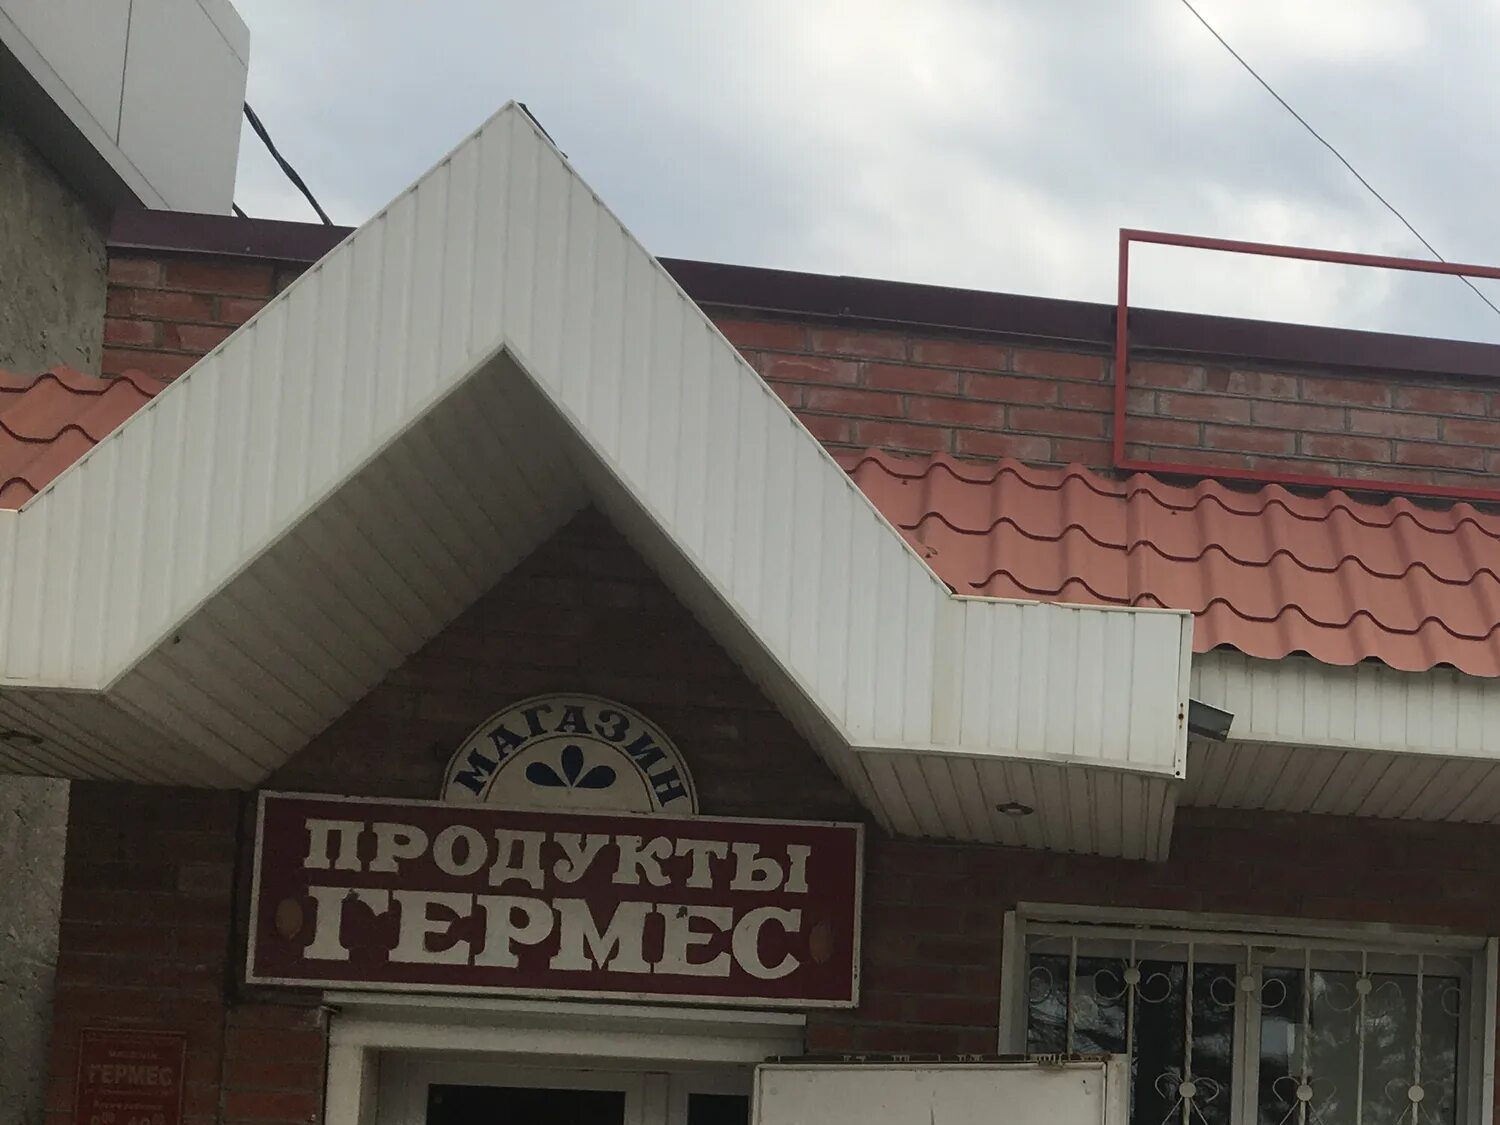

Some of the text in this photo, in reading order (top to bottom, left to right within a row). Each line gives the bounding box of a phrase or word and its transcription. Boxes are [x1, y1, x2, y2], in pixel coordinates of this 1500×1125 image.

[454, 704, 688, 808] МАГАЗИН
[304, 818, 811, 893] ПРОДУКТЫ
[303, 885, 802, 980] ГЕРМЕС
